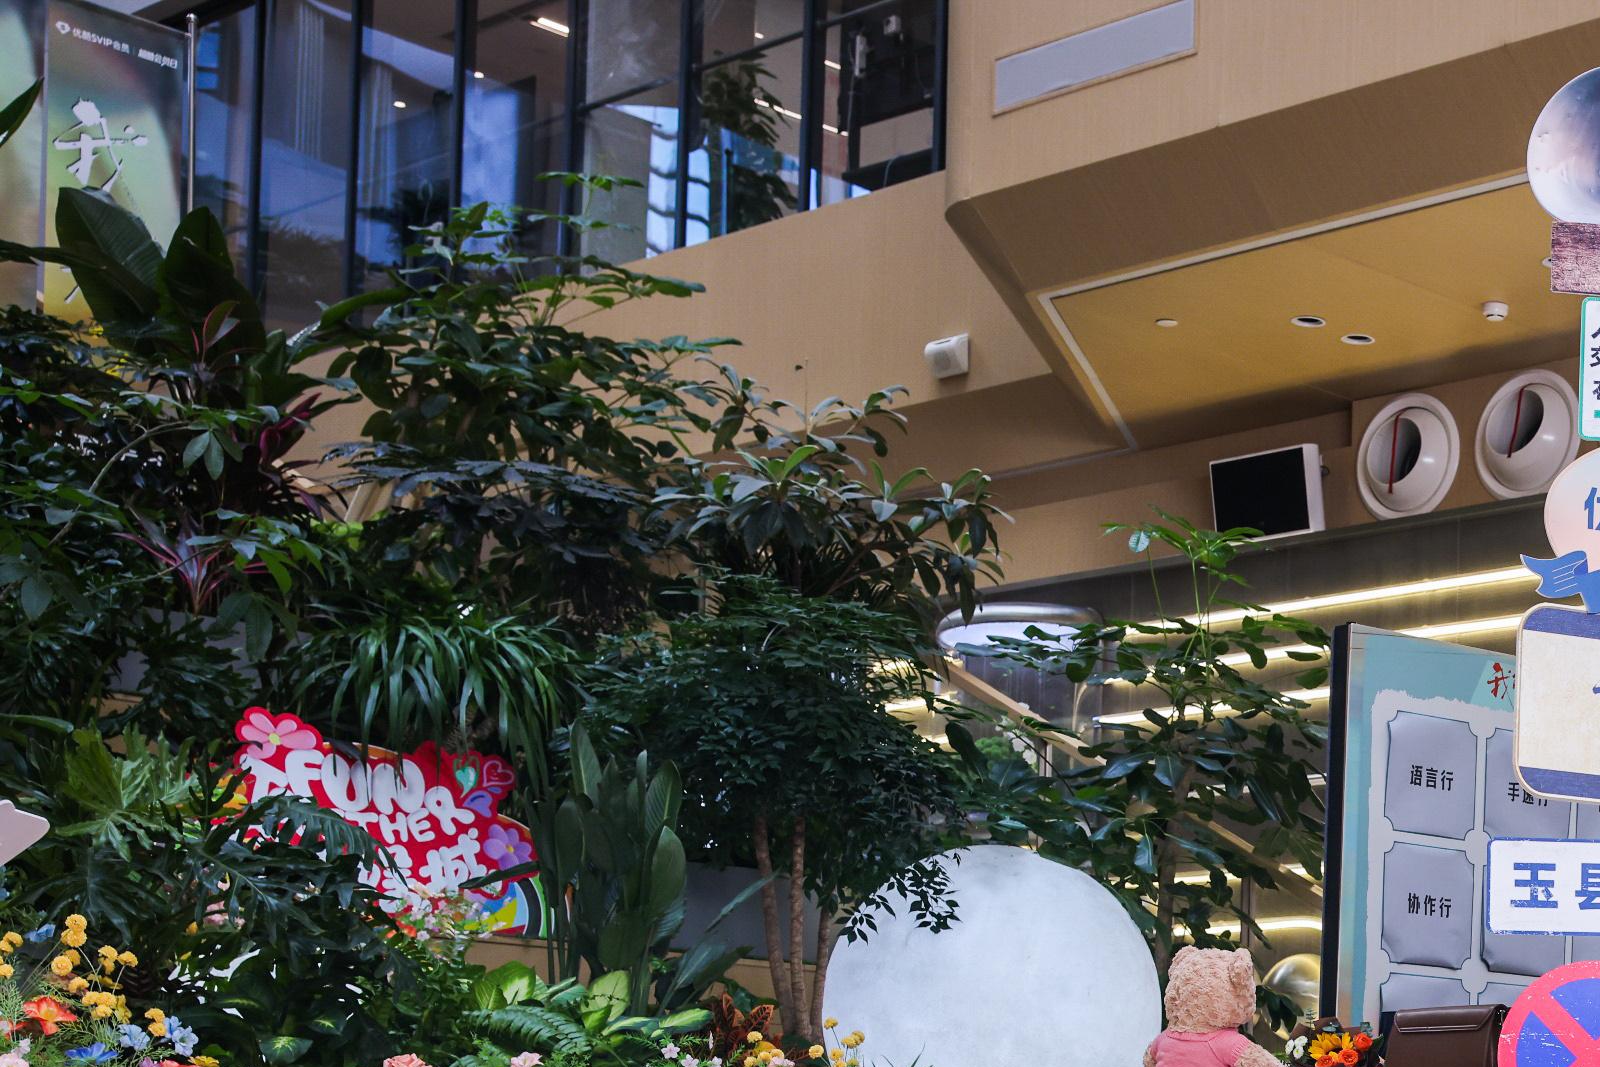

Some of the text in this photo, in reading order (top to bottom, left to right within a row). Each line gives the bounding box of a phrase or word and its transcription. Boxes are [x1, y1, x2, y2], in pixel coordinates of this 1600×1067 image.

[1487, 662, 1517, 700] 我
[1409, 764, 1454, 792] 语言行
[1407, 891, 1452, 918] 协作行
